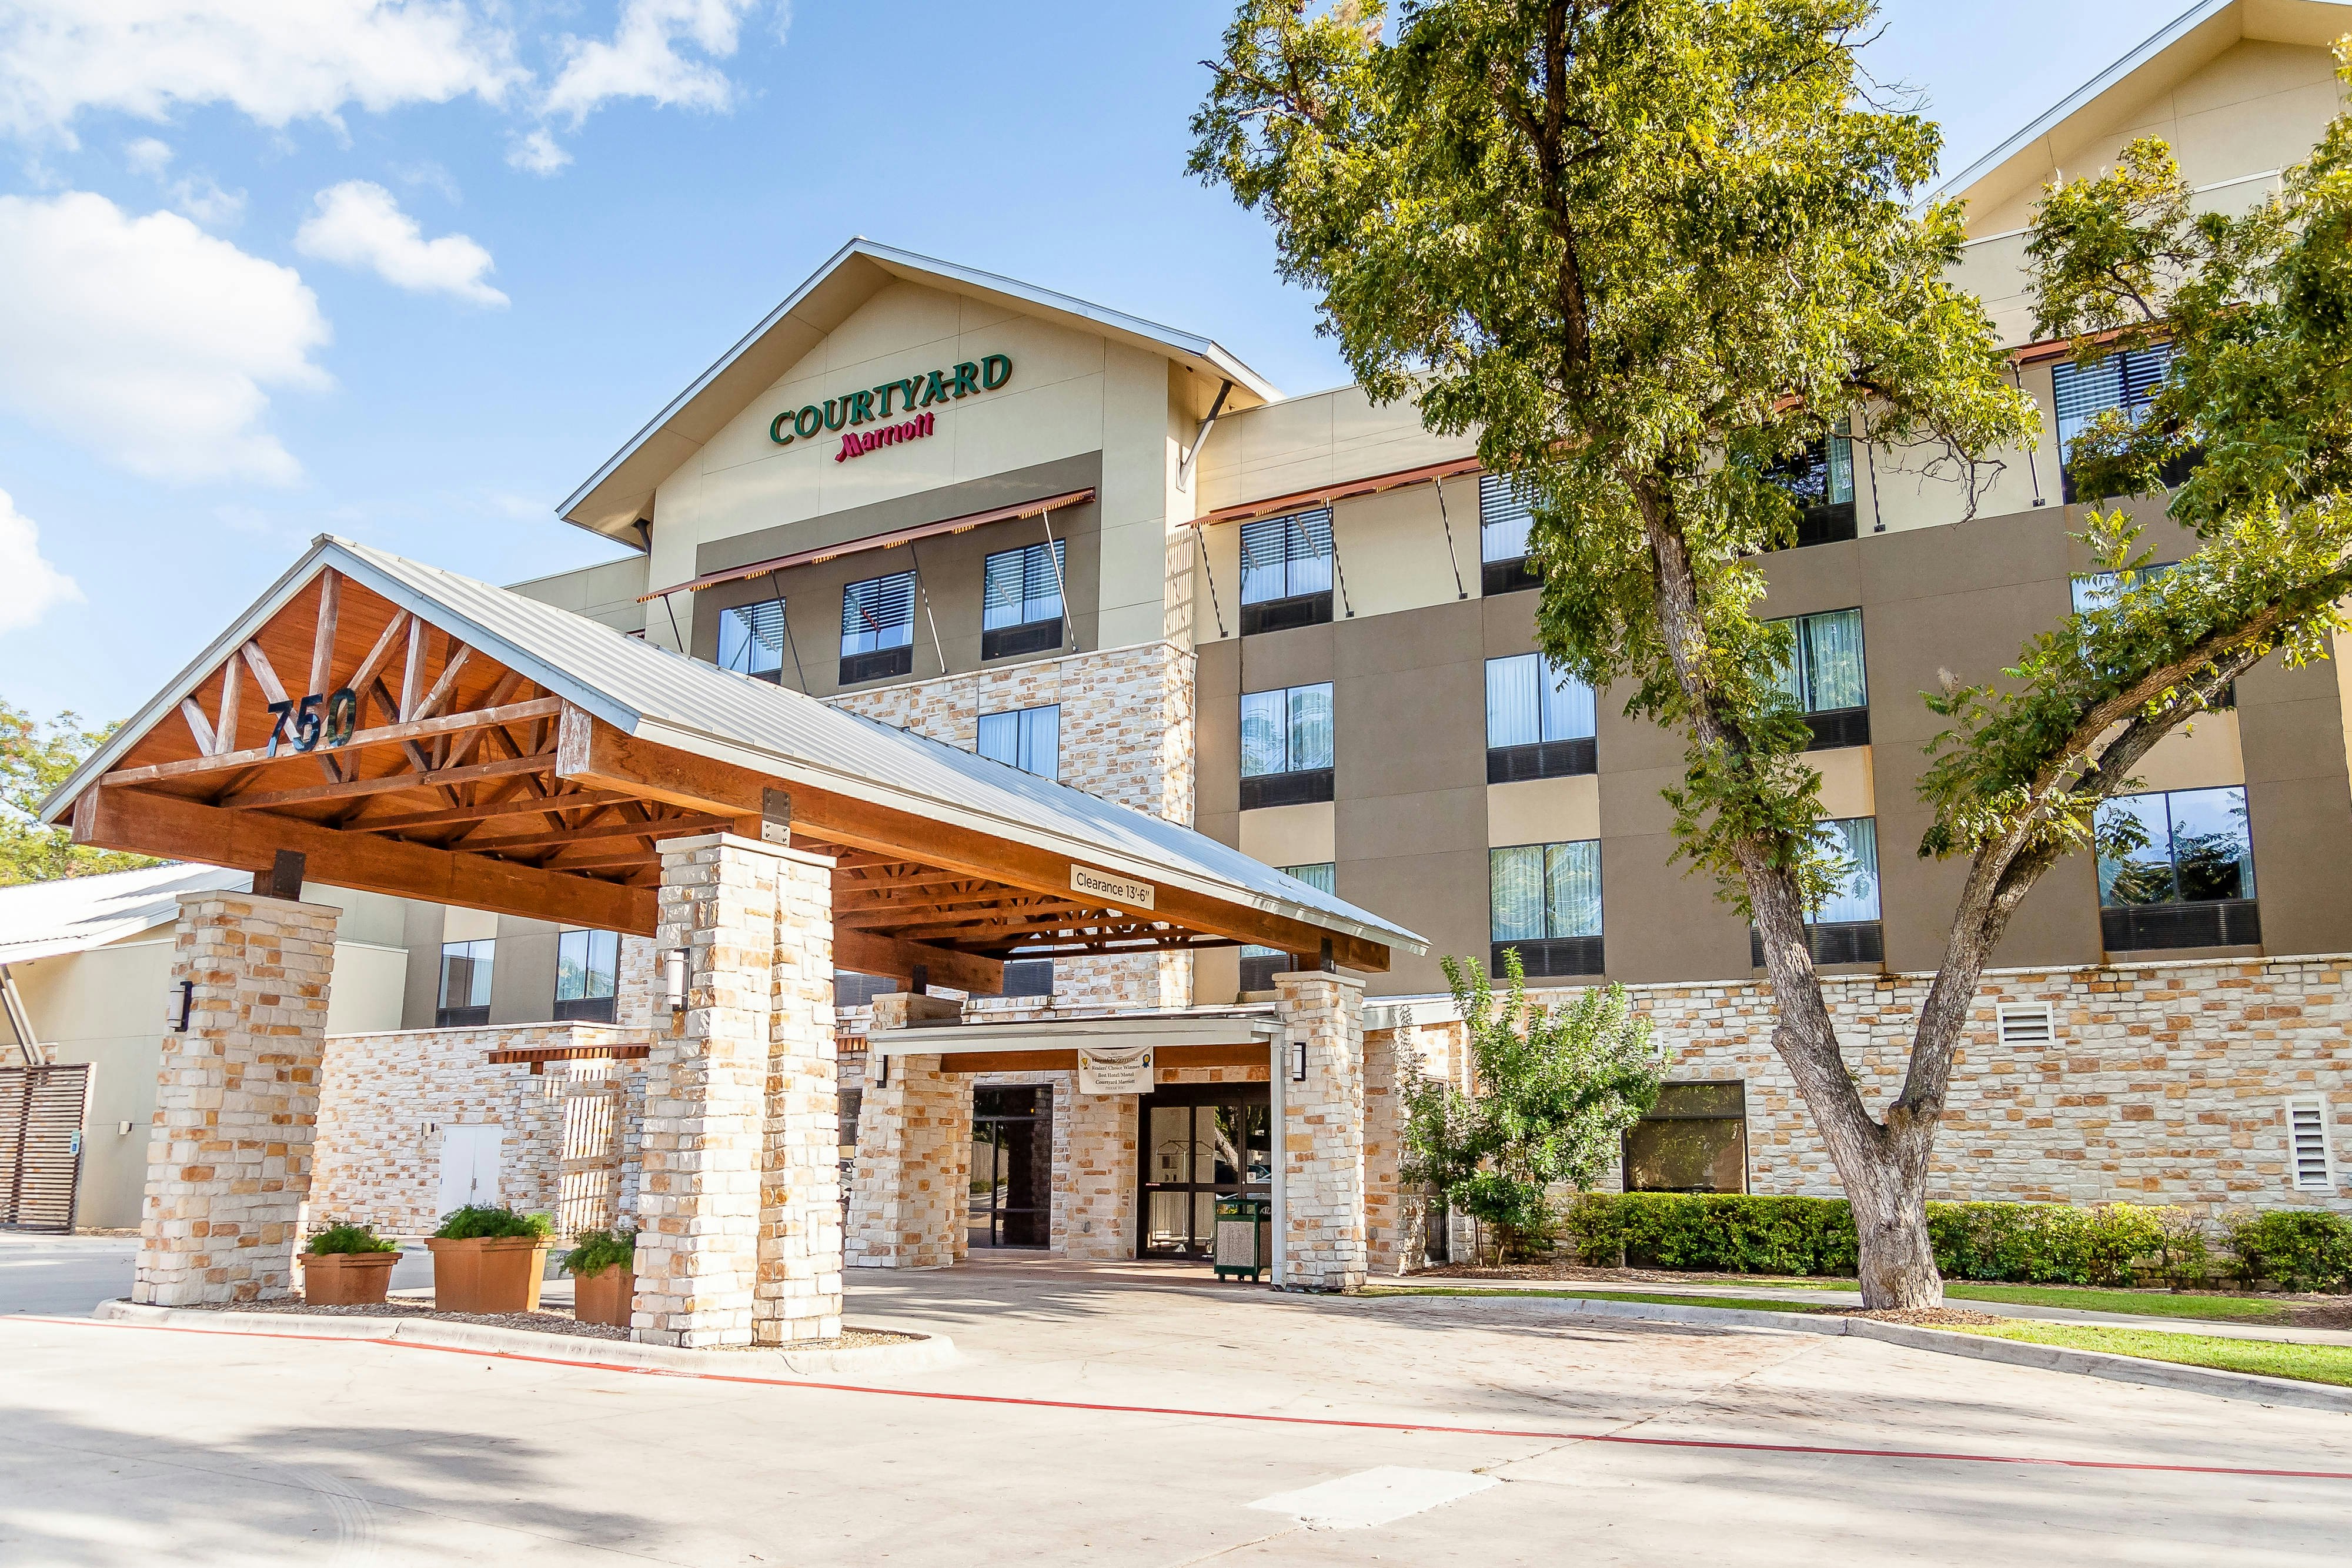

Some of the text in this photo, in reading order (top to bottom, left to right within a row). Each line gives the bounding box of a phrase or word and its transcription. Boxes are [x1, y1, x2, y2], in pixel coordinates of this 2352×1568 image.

[769, 354, 1013, 445] COURTYARD
[834, 412, 936, 463] Marriott
[267, 687, 356, 758] 750
[1077, 872, 1150, 902] Clearance 13'-6"
